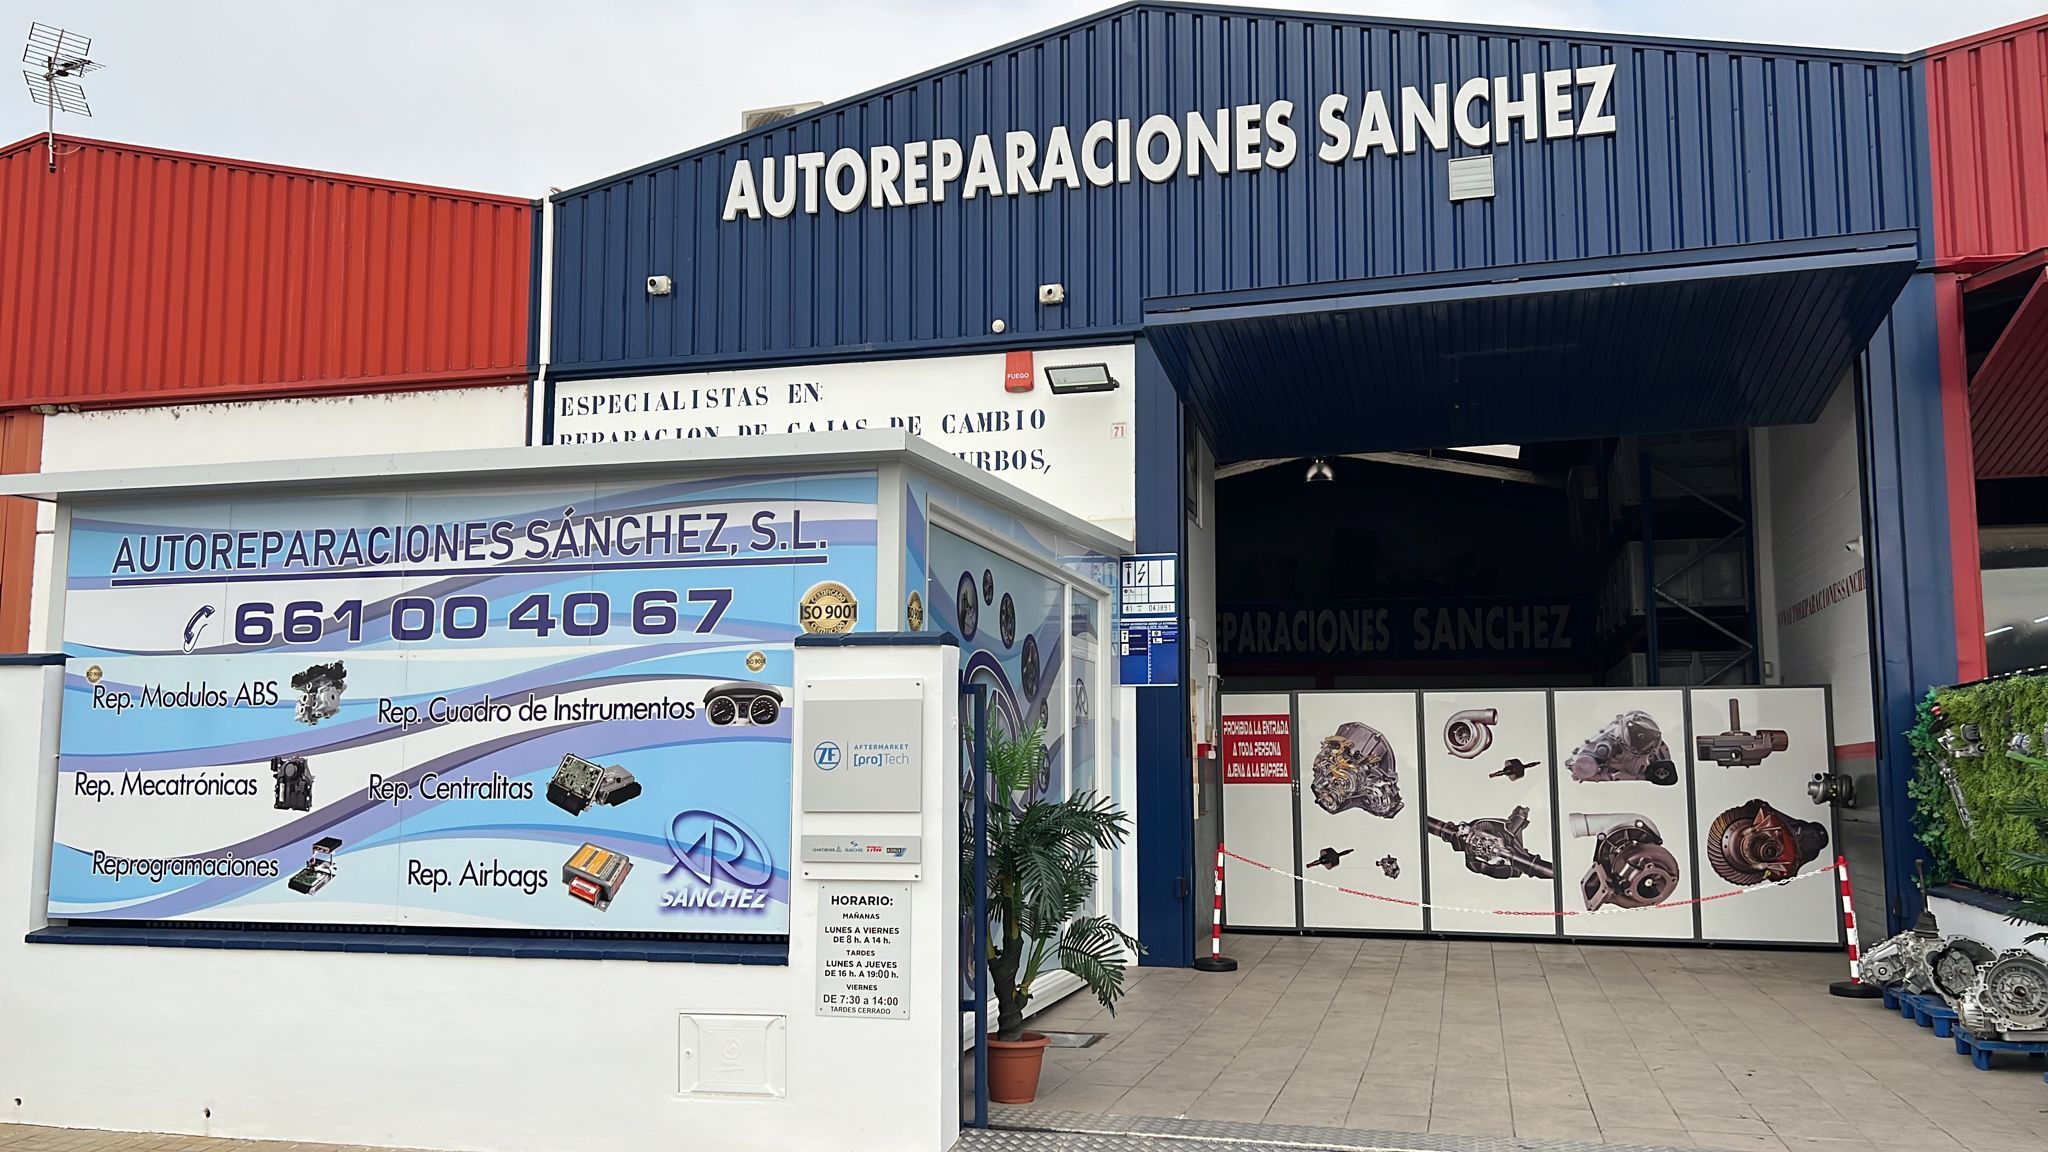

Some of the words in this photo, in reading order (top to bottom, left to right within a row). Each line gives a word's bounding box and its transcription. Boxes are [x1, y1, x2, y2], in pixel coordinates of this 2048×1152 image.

[722, 99, 1298, 221] AUTOREPARACIONES
[1318, 63, 1617, 164] SANCHEZ
[1007, 372, 1029, 380] FUEGO
[561, 386, 769, 417] ESPECIALISTAS
[942, 409, 1046, 434] CAMBIO
[1114, 426, 1124, 437] 71
[111, 520, 514, 574] AUTOREPARACIONES
[525, 507, 739, 559] SÁNCHEZ,
[750, 509, 827, 551] S.L.
[235, 600, 363, 645] 661
[391, 596, 488, 642] 00
[508, 592, 610, 637] 40
[633, 589, 733, 636] 67
[800, 605, 822, 619] ISO
[825, 605, 857, 619] 9001
[1413, 604, 1572, 651] SANCHEZ
[93, 684, 134, 714] Rep.
[140, 681, 228, 708] Modulos
[234, 681, 278, 706] ABS
[378, 698, 421, 729] Rep.
[429, 695, 511, 723] Cuadro
[517, 694, 547, 722] de
[554, 695, 696, 721] Instrumentos
[1223, 721, 1253, 735] PROHIBIDA
[1254, 721, 1262, 735] LA
[1262, 720, 1289, 735] ENTRADA
[815, 746, 840, 766] ZF
[1232, 742, 1238, 756] A
[1238, 742, 1253, 756] TODA
[1254, 742, 1281, 756] PERSONA
[1227, 763, 1245, 777] AJENA
[1246, 763, 1251, 777] A
[1252, 763, 1260, 777] LA
[1260, 763, 1288, 777] EMPRESA
[74, 771, 114, 802] Rep.
[121, 771, 258, 796] Mecatrónicas
[369, 773, 413, 806] Rep.
[419, 771, 533, 801] Centralitas
[92, 850, 279, 882] Reprogramaciones
[408, 859, 452, 888] Rep.
[459, 860, 548, 895] Airbags
[831, 895, 893, 906] HORARIO:
[842, 911, 880, 920] MAÑANAS
[846, 935, 852, 943] 8
[867, 969, 889, 978] 19:00
[823, 994, 837, 1003] DE
[840, 995, 861, 1004] 7:30
[872, 996, 899, 1006] 14:00
